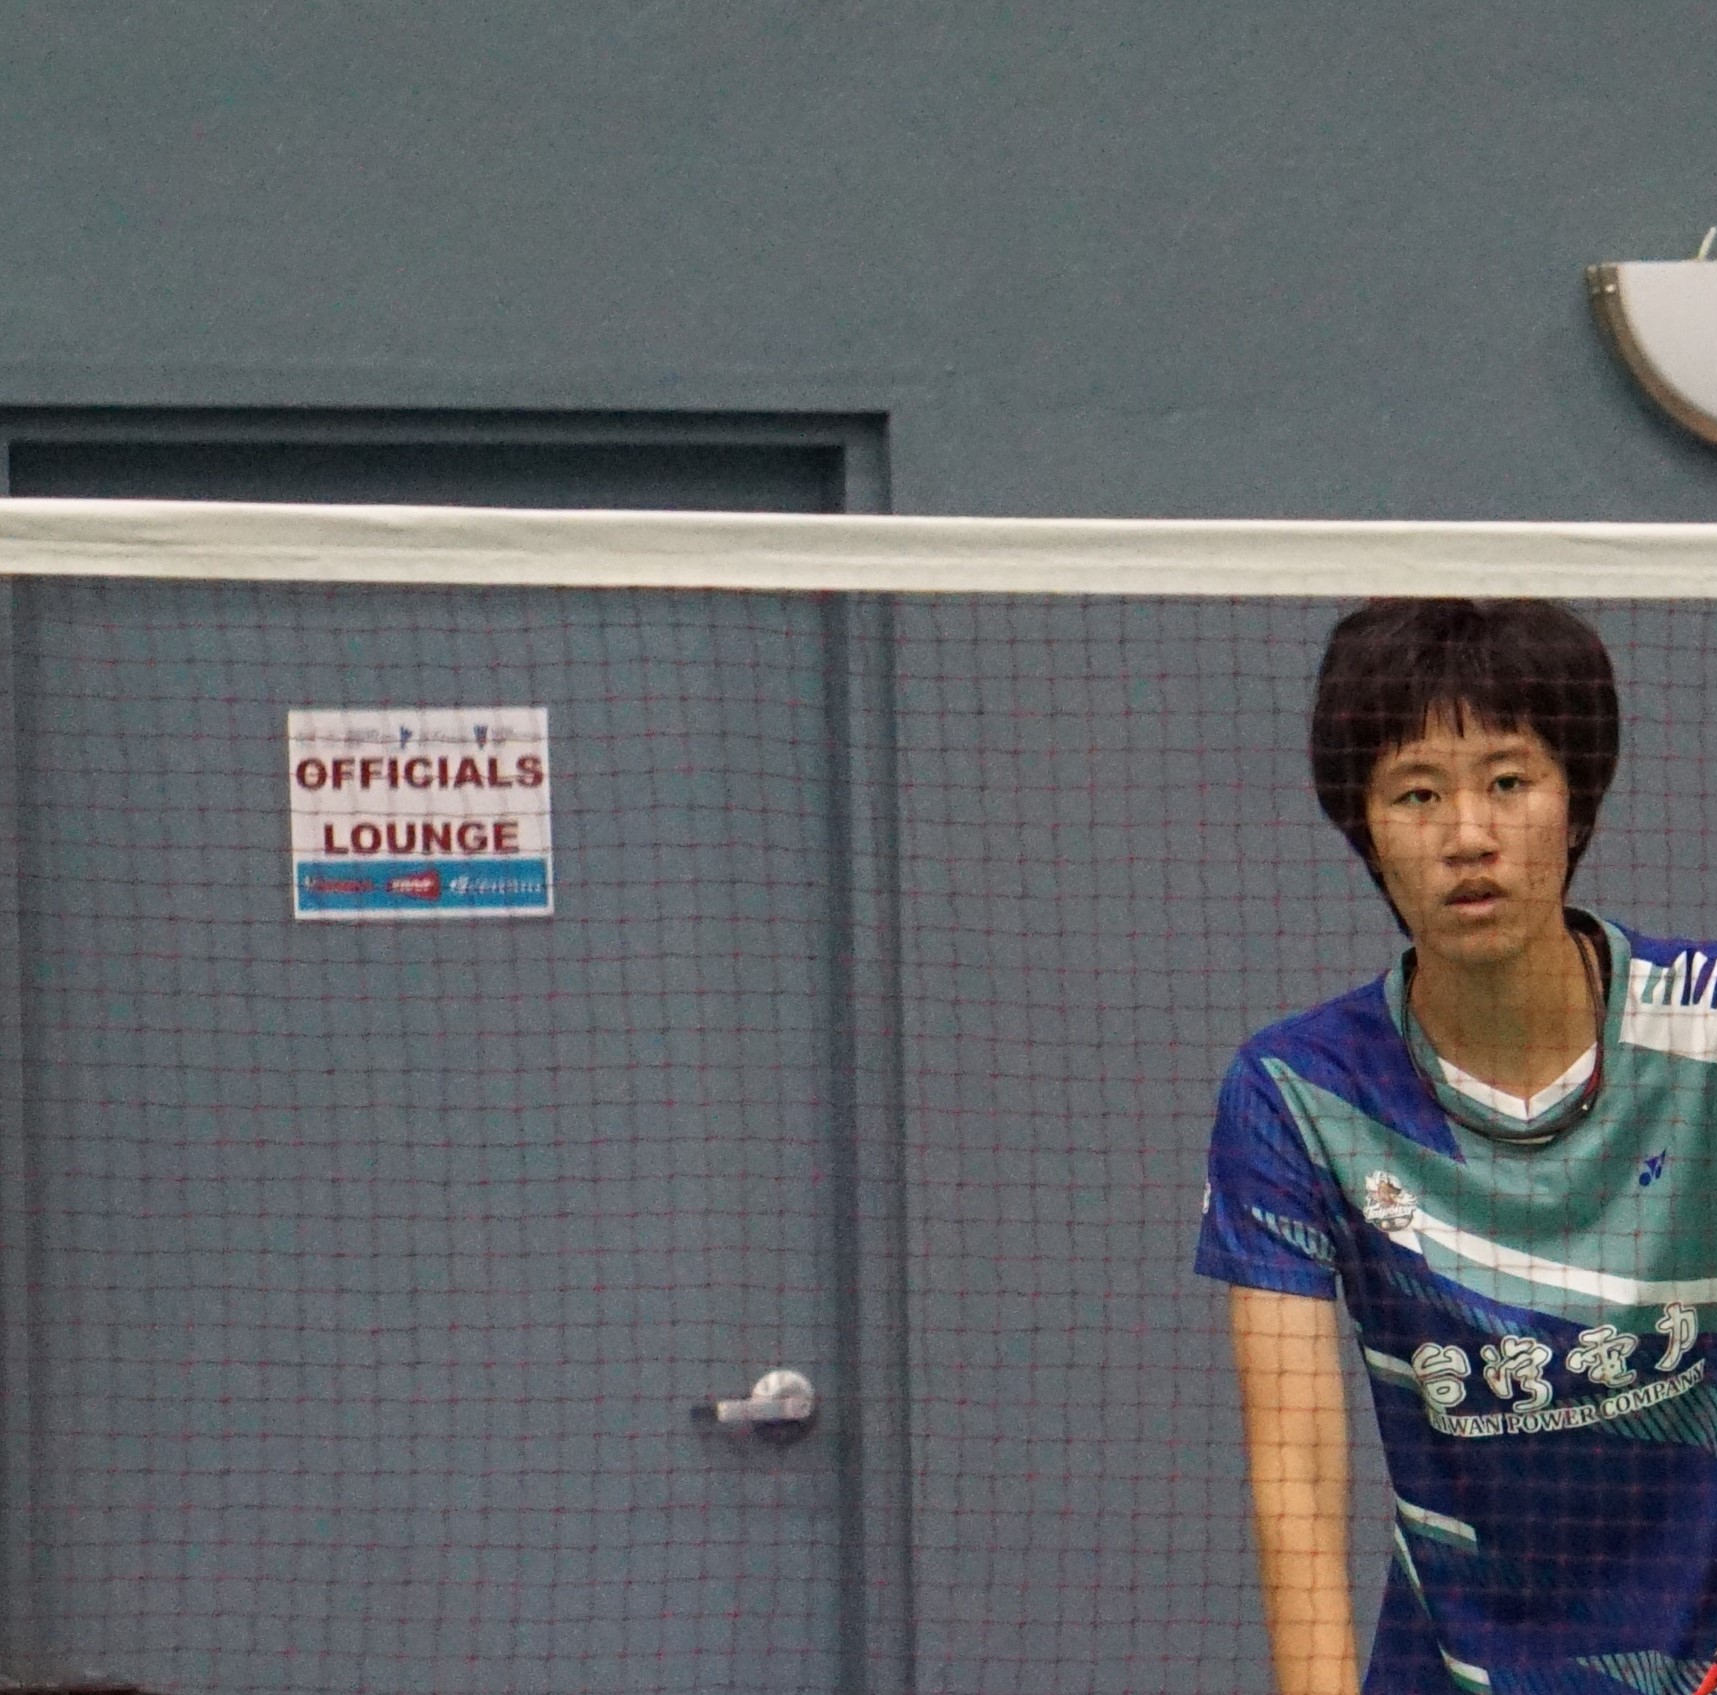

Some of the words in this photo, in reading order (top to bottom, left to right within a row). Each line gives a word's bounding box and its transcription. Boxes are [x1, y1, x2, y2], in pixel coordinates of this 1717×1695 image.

[295, 755, 544, 791] OFFICIALS
[324, 821, 520, 855] LOUNGE
[1429, 1412, 1503, 1438] AIWAN
[1506, 1403, 1599, 1434] POWER
[1600, 1358, 1706, 1420] COMPANY
